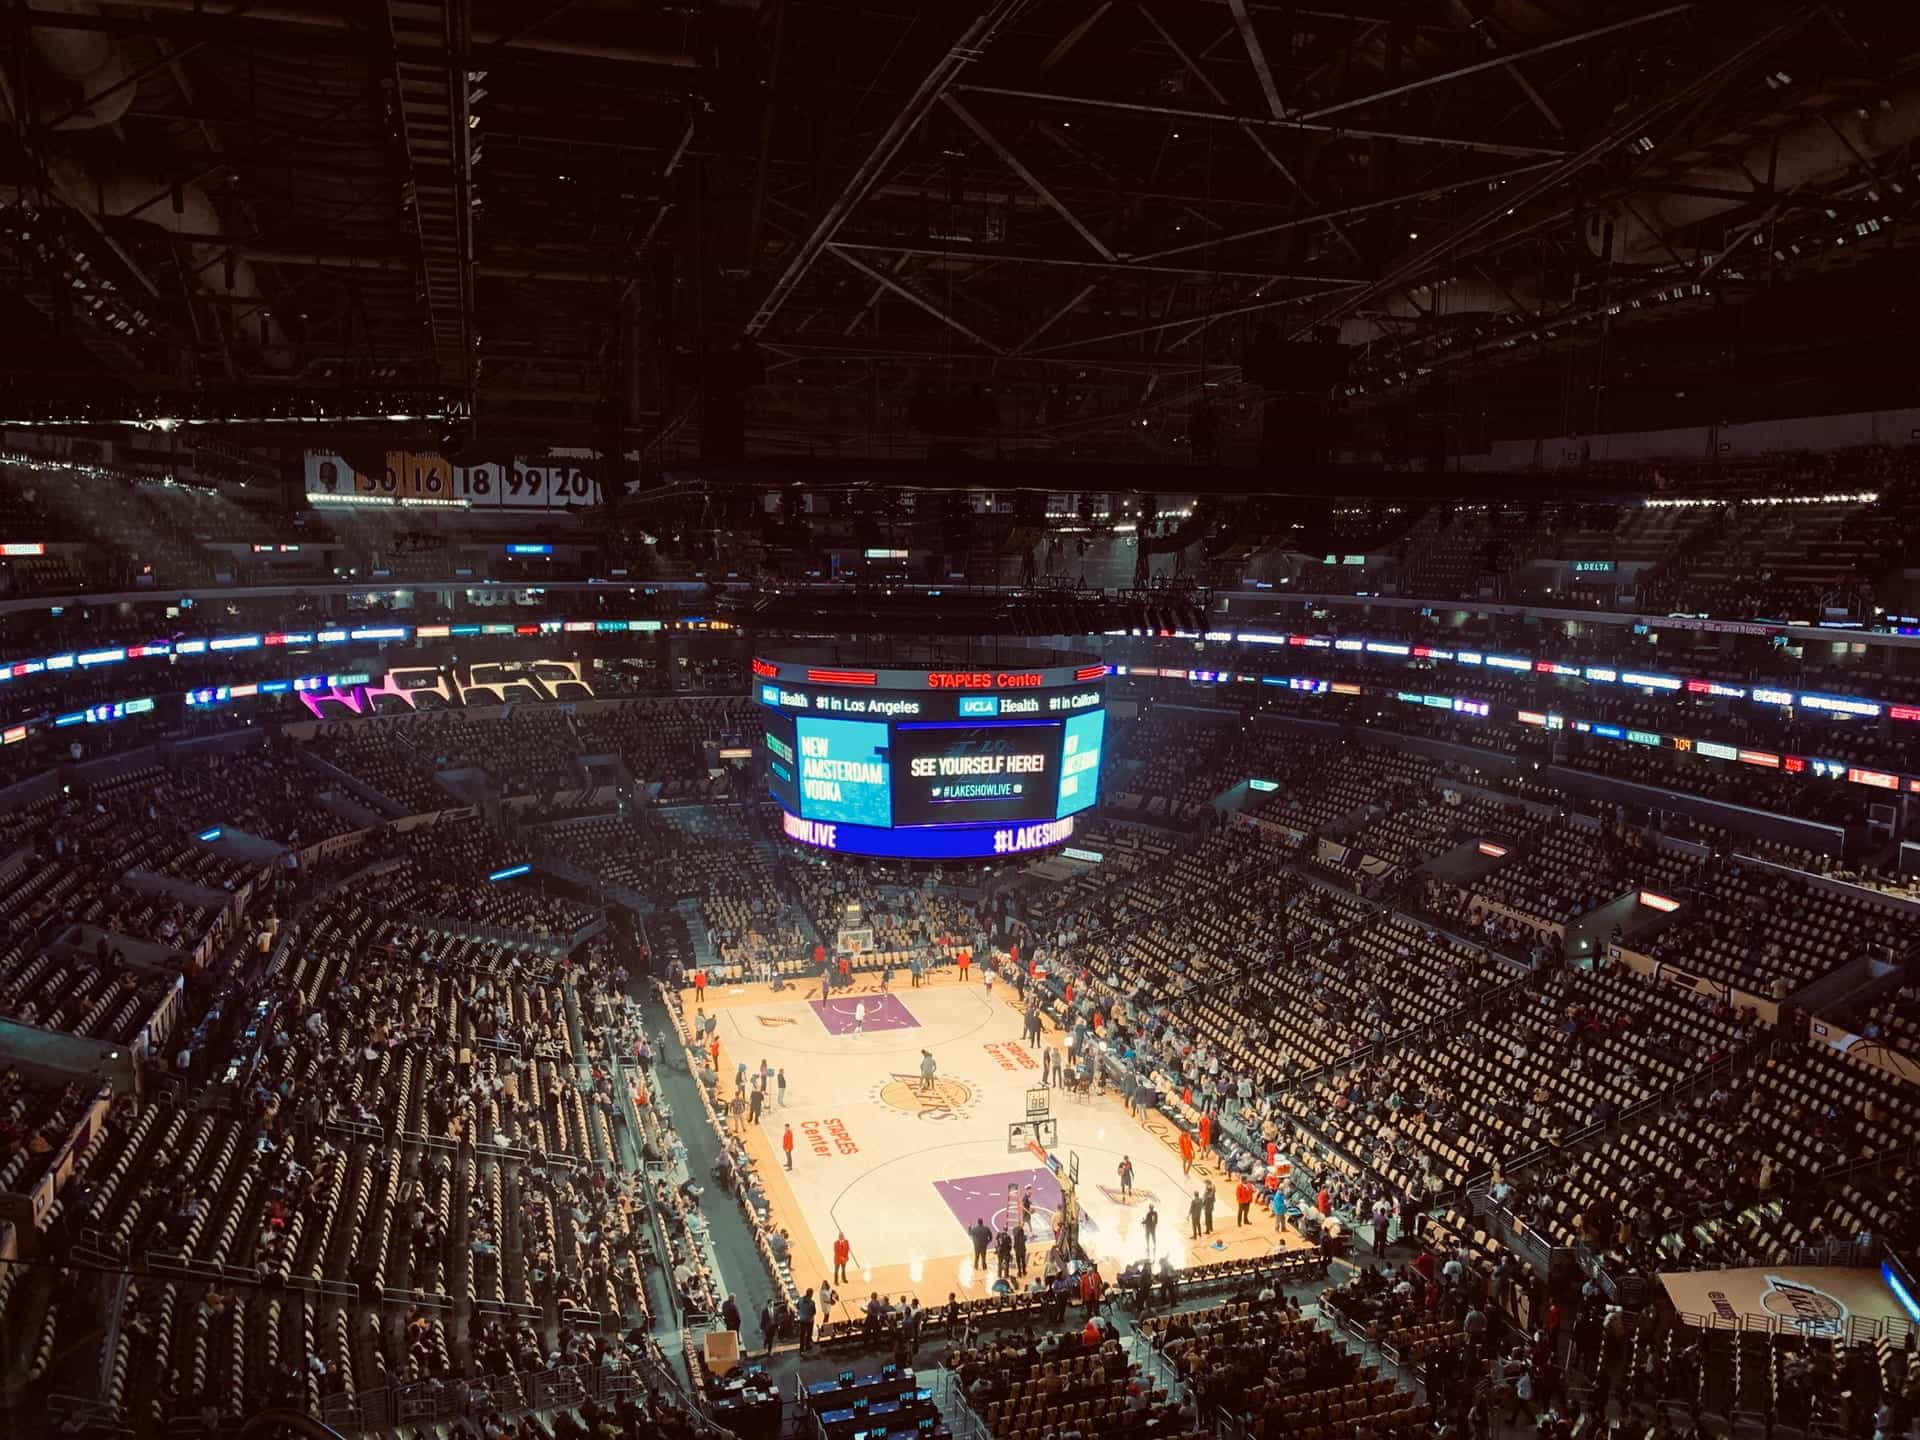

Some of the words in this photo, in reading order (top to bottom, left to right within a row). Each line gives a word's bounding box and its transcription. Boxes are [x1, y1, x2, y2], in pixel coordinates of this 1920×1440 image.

[415, 467, 442, 493] 16
[462, 468, 490, 496] 18
[510, 468, 541, 496] 99
[556, 468, 589, 496] 20
[1583, 563, 1609, 571] DELTA
[928, 673, 992, 688] STAPLES
[997, 673, 1043, 688] Center
[780, 691, 809, 708] Health
[815, 696, 829, 709] #1
[831, 697, 841, 710] in
[844, 698, 865, 712] Los
[868, 700, 920, 716] Angeles
[964, 701, 993, 712] UCLA
[1000, 699, 1040, 713] Health
[1062, 696, 1071, 709] in
[801, 736, 829, 758] NEW
[803, 758, 883, 785] AMSTERDAM
[911, 757, 937, 777] SEE
[939, 756, 1004, 776] YOURSELF
[1006, 755, 1044, 774] HERE!
[804, 779, 842, 802] VODKA
[943, 783, 1011, 798] #LAKESHOWLIVE
[983, 1043, 1018, 1071] Center
[1001, 1041, 1039, 1070] STAPLES
[800, 1120, 832, 1158] Center
[824, 1118, 859, 1156] STAPLES
